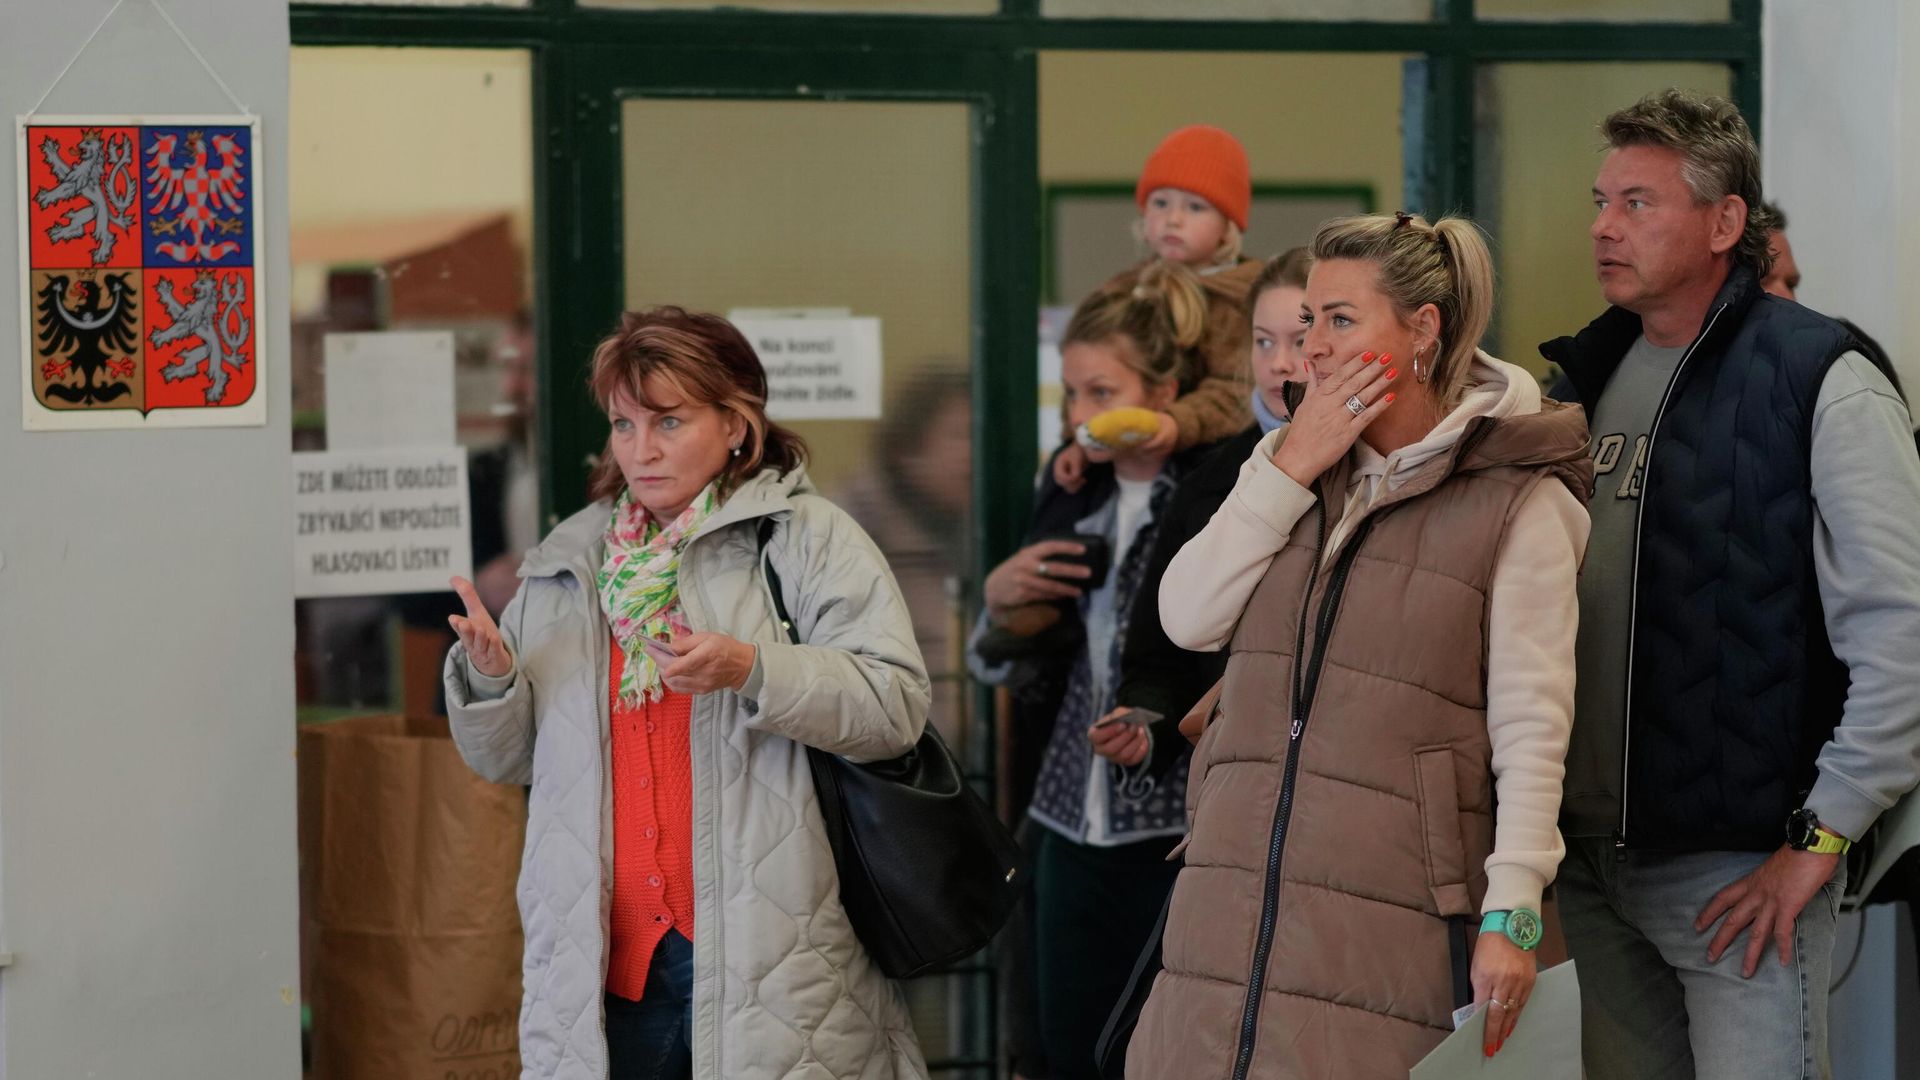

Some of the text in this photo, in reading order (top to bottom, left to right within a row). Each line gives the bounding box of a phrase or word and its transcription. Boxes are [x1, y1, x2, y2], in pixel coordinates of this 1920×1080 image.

[759, 338, 834, 354] Na konci
[297, 461, 458, 494] ZDE MŮŽETE ODLOŽIT
[297, 504, 374, 536] ZBÝVAJÍCÍ
[311, 545, 451, 576] HLASOVACÍ LÍSTKY
